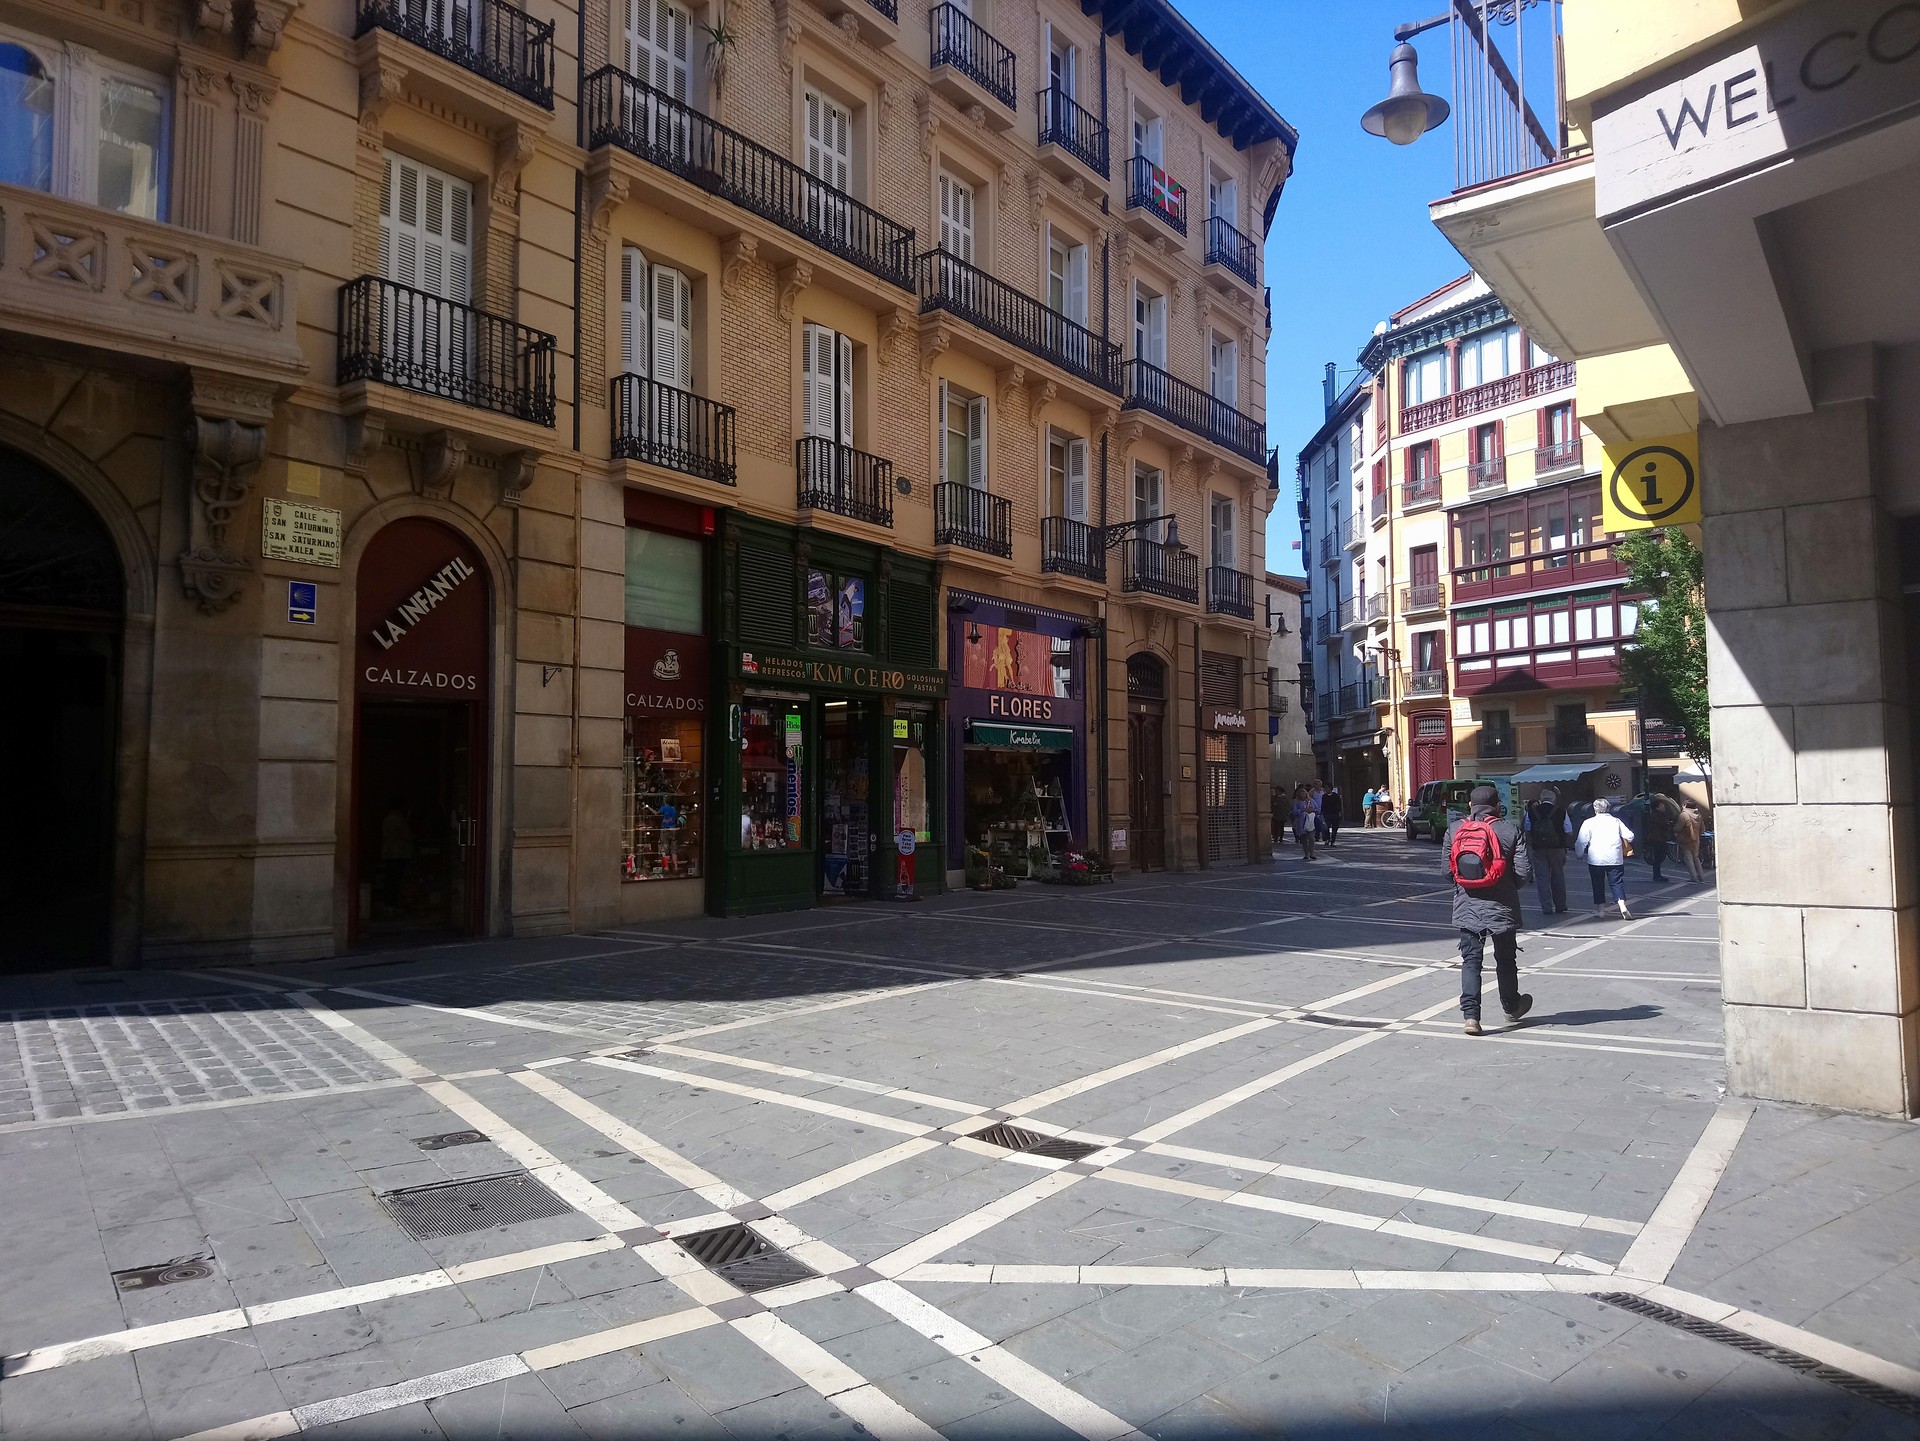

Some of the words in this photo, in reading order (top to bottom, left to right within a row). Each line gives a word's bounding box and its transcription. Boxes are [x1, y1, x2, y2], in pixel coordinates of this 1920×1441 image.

[294, 510, 317, 521] CALLE
[271, 517, 287, 527] SAN
[293, 521, 334, 535] SATURNINO
[269, 531, 286, 542] SAN
[291, 535, 336, 549] SATURNINO
[288, 544, 315, 556] KALEA
[372, 619, 407, 650] LA
[398, 556, 475, 627] INFANTIL
[764, 655, 804, 668] HELADOS
[365, 666, 476, 690] CALZADOS
[761, 665, 807, 679] REFRESCOS
[812, 661, 843, 684] KM
[906, 673, 945, 685] GOLOSINAS
[912, 683, 938, 693] PASTAS
[626, 692, 705, 711] CALZADOS
[989, 694, 1053, 720] FLORES
[787, 759, 799, 816] mentos
